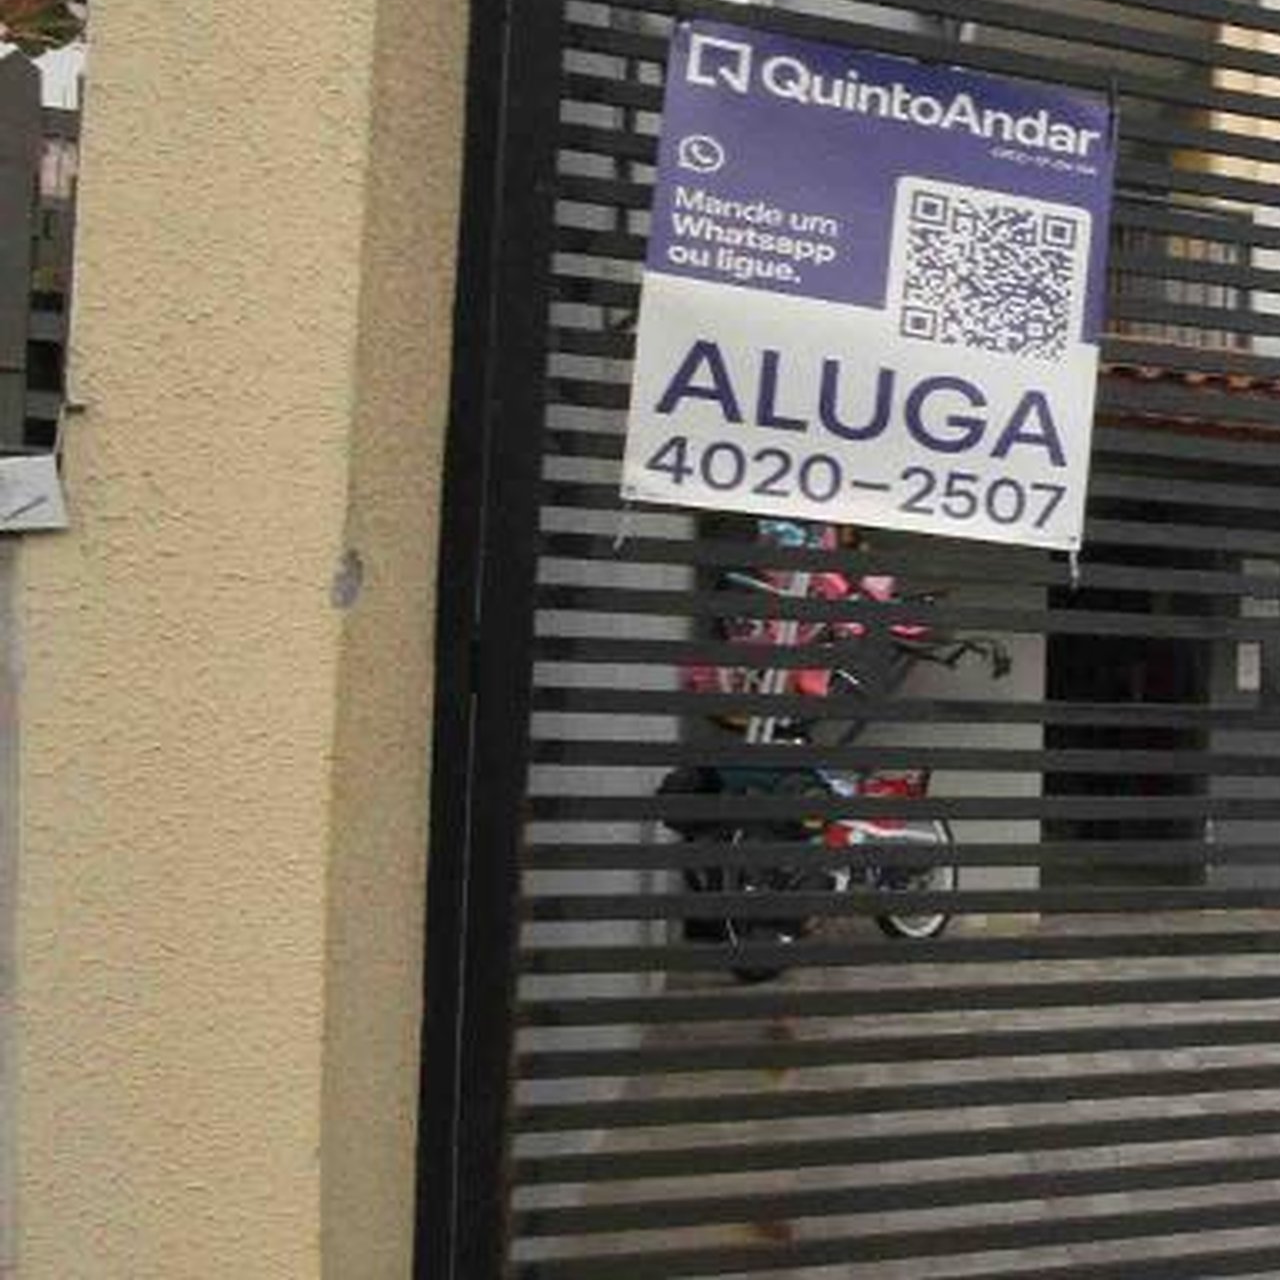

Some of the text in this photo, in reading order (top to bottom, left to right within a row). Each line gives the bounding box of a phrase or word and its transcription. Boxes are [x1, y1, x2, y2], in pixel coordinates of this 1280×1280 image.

[762, 56, 1100, 156] QuintoAndar
[671, 213, 836, 265] Whatsapp
[675, 186, 838, 237] Mande um
[667, 245, 801, 284] ou ligue.
[655, 338, 1067, 468] ALUGA
[645, 434, 1066, 529] 4020-2507
